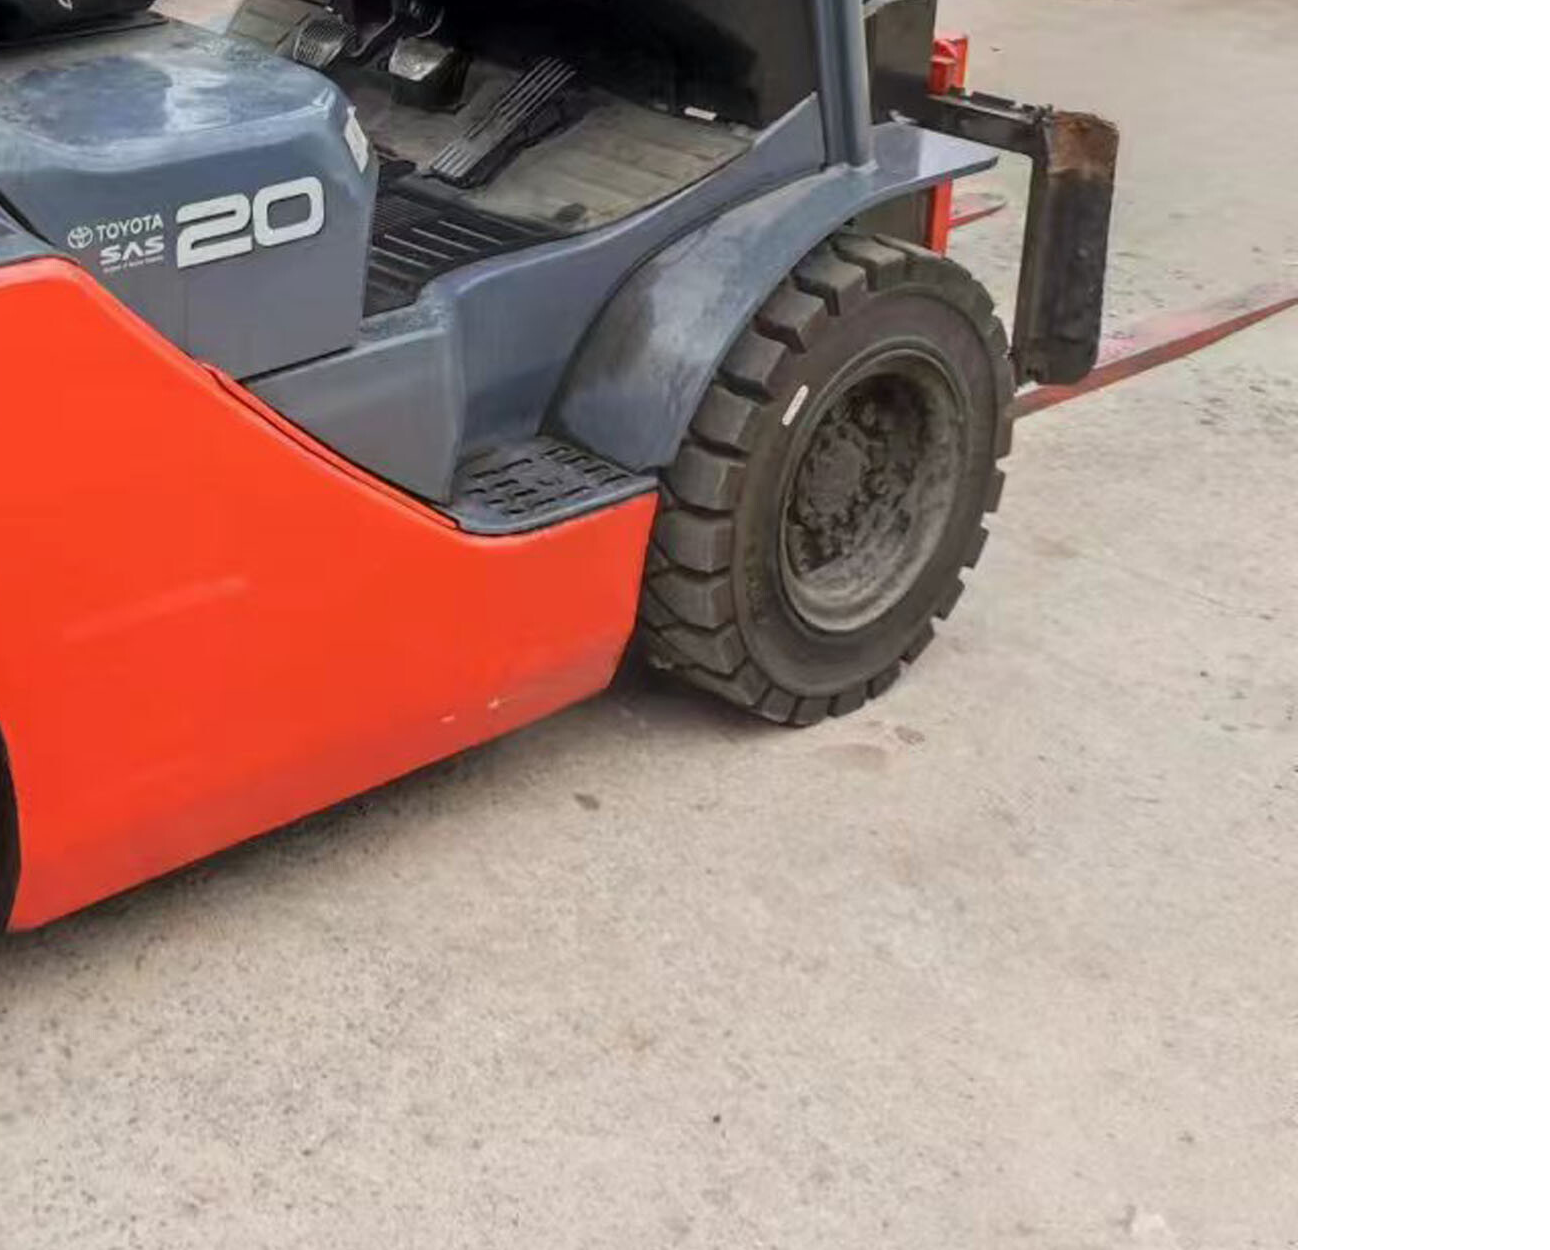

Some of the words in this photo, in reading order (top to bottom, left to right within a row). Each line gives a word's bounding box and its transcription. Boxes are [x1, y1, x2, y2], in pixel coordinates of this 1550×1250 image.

[96, 213, 164, 241] TOYOTA
[175, 177, 325, 268] 20
[99, 234, 165, 266] SAS
